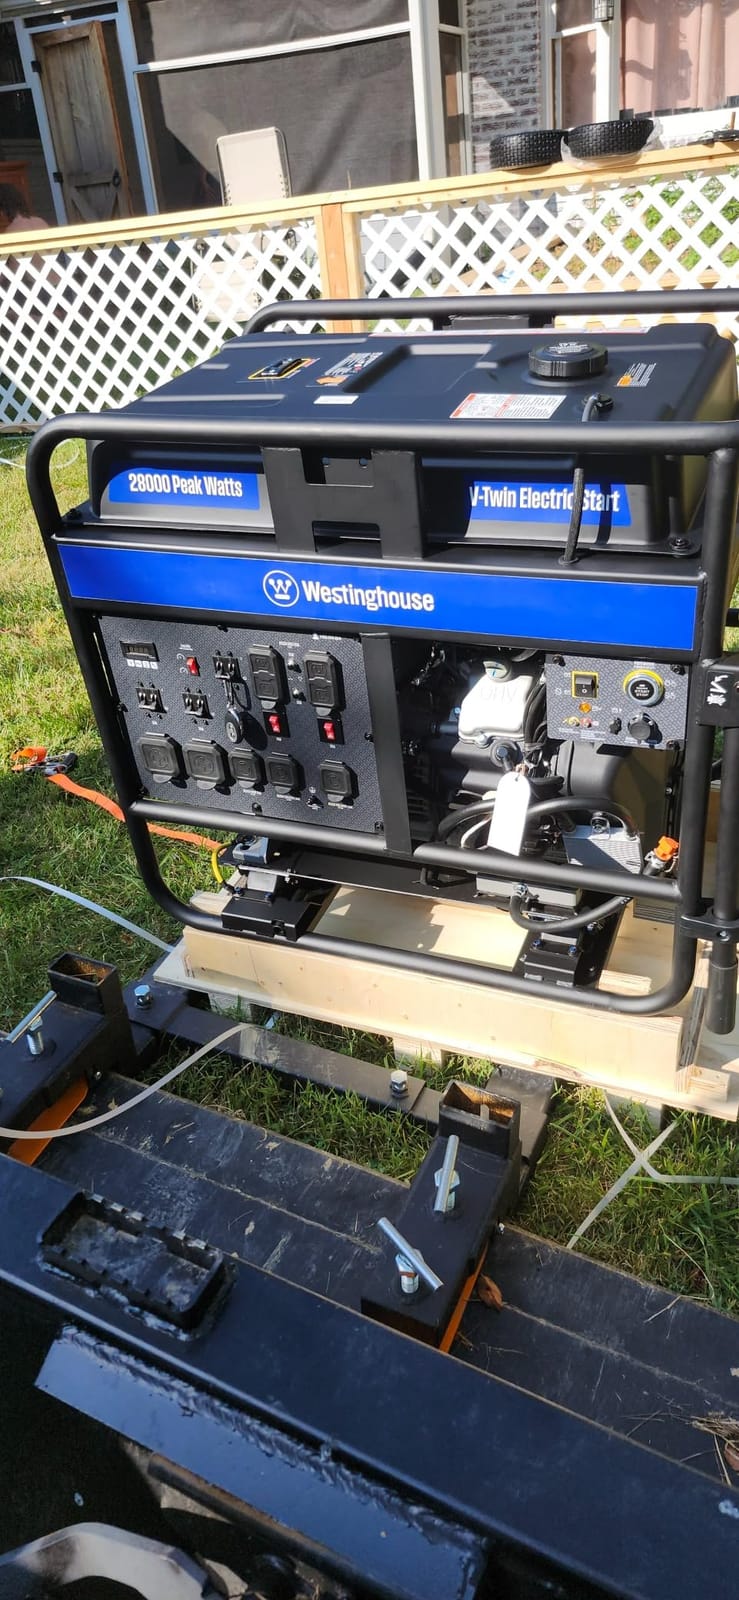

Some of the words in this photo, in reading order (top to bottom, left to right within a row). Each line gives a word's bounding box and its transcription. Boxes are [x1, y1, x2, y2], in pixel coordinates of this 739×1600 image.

[128, 473, 171, 493] 28000
[172, 475, 202, 496] Peak
[203, 476, 243, 498] Watts
[469, 486, 516, 508] V-Twin
[519, 487, 573, 510] Electric
[582, 489, 620, 513] Start
[301, 580, 435, 612] Westinghouse
